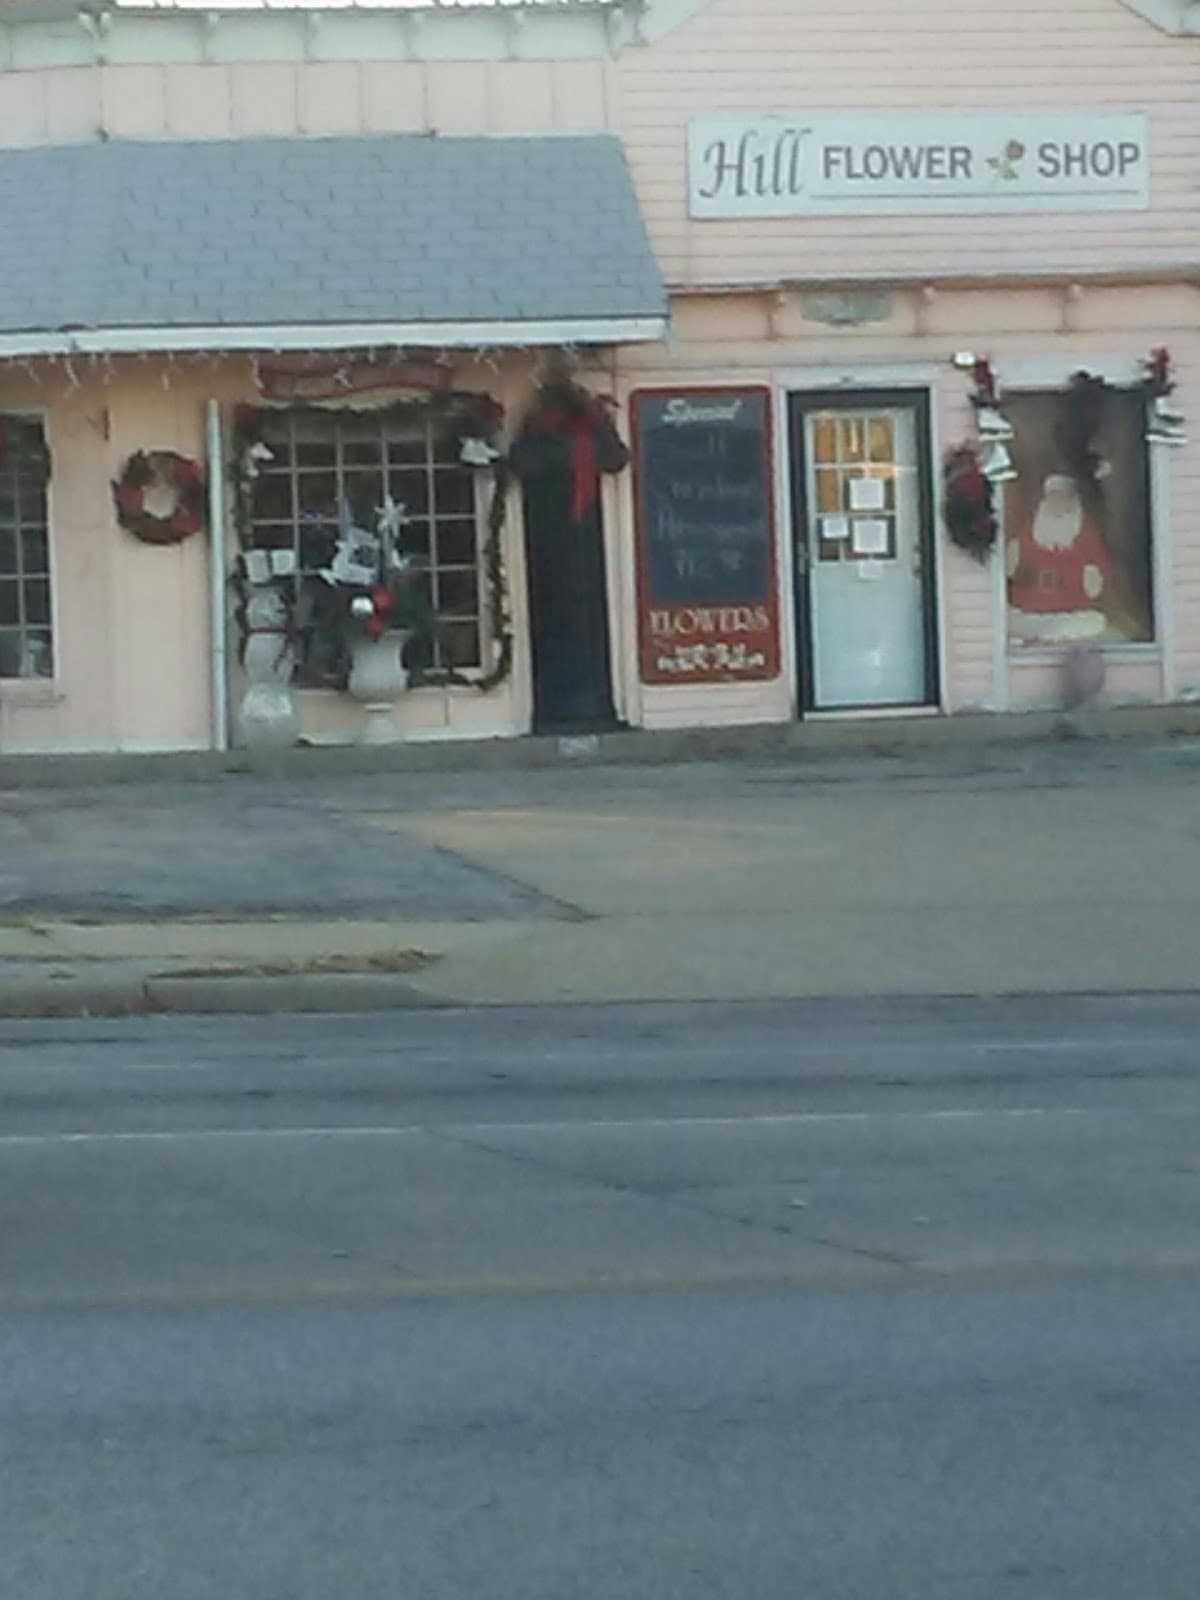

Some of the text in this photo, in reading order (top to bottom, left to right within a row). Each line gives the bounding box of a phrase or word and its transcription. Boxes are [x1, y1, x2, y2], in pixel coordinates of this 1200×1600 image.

[699, 129, 1140, 199] Hill FLOWER SHOP
